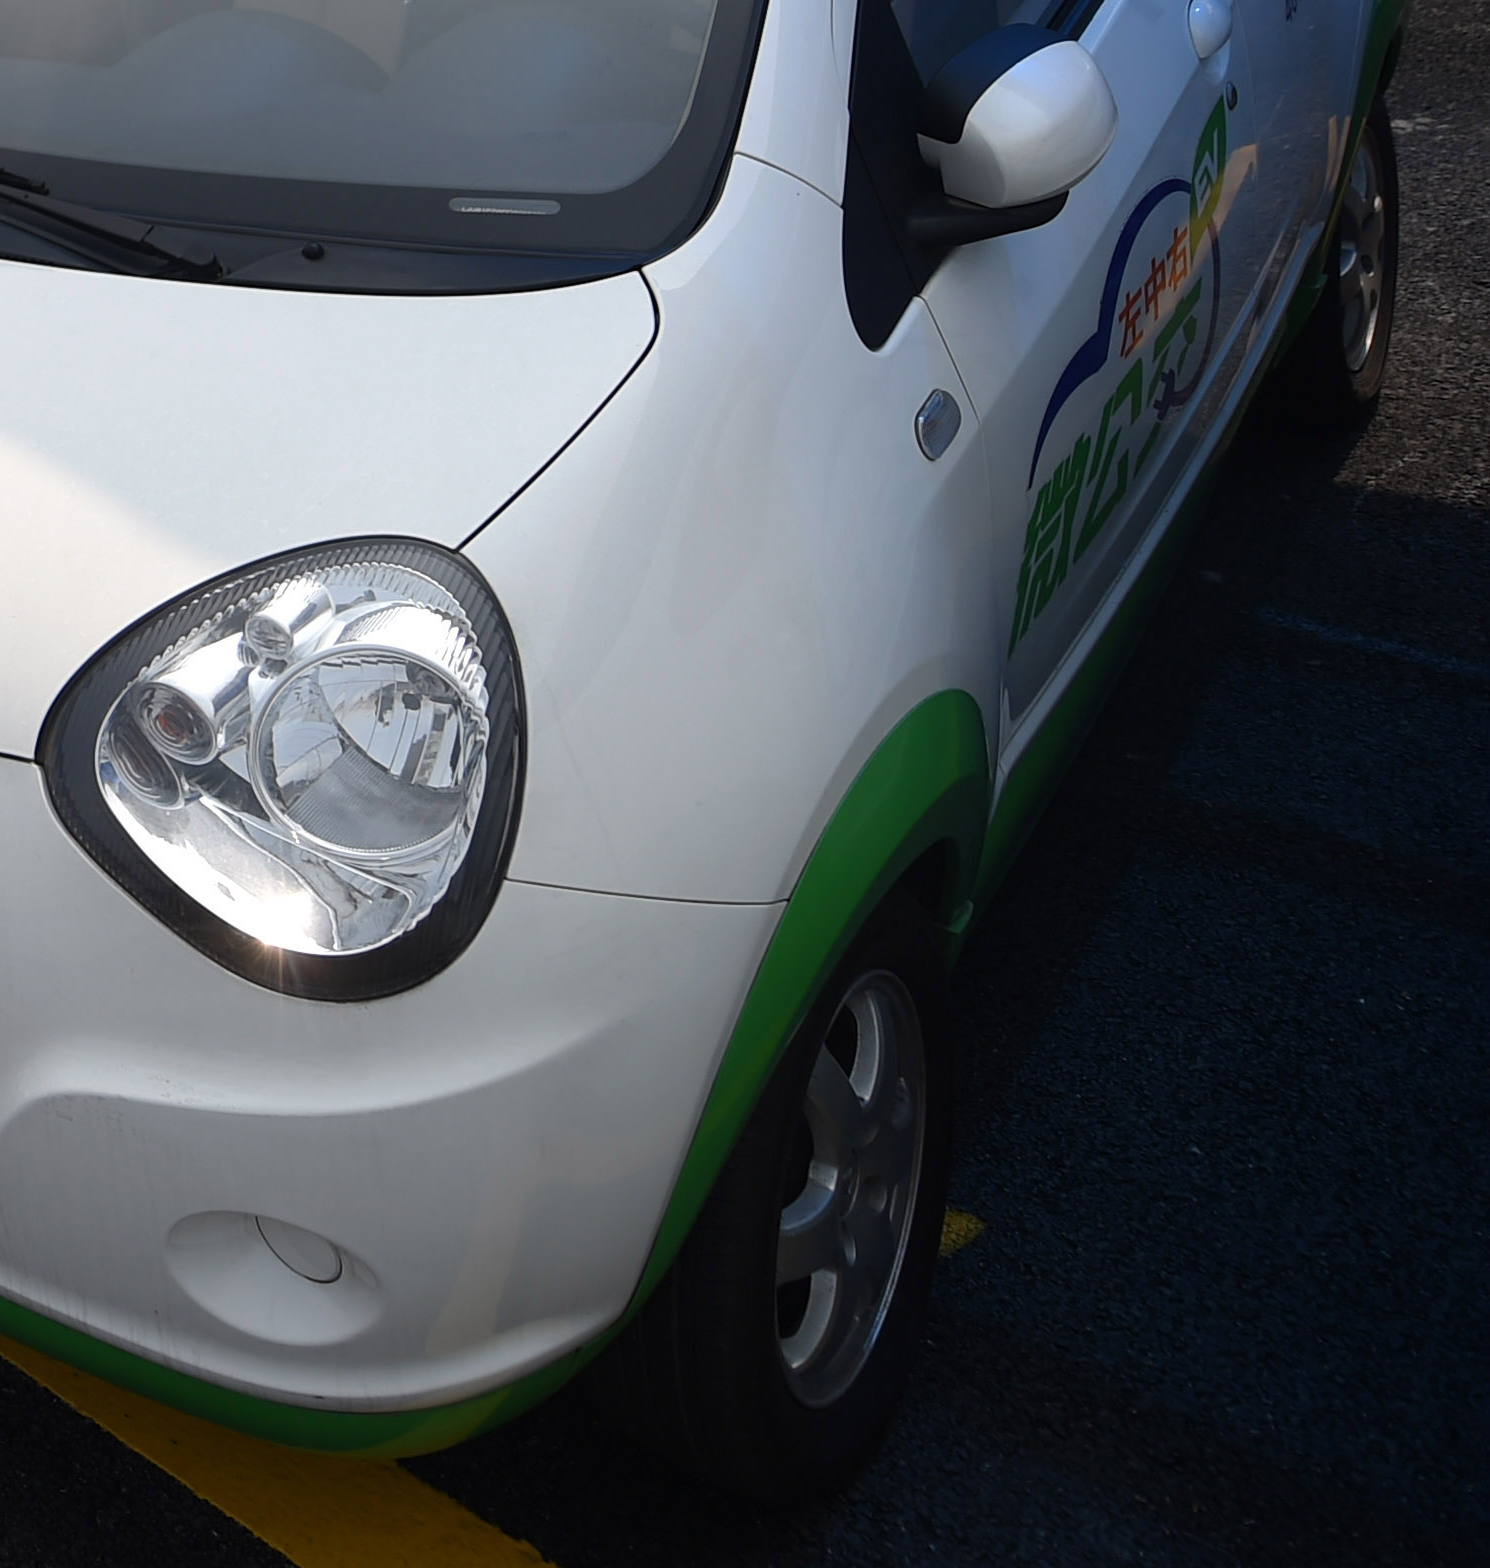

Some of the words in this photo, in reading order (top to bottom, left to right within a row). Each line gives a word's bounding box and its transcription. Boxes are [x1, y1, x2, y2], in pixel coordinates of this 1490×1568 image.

[1195, 126, 1220, 206] EV
[1119, 225, 1188, 360] 左中右
[1007, 277, 1203, 664] 微公交
